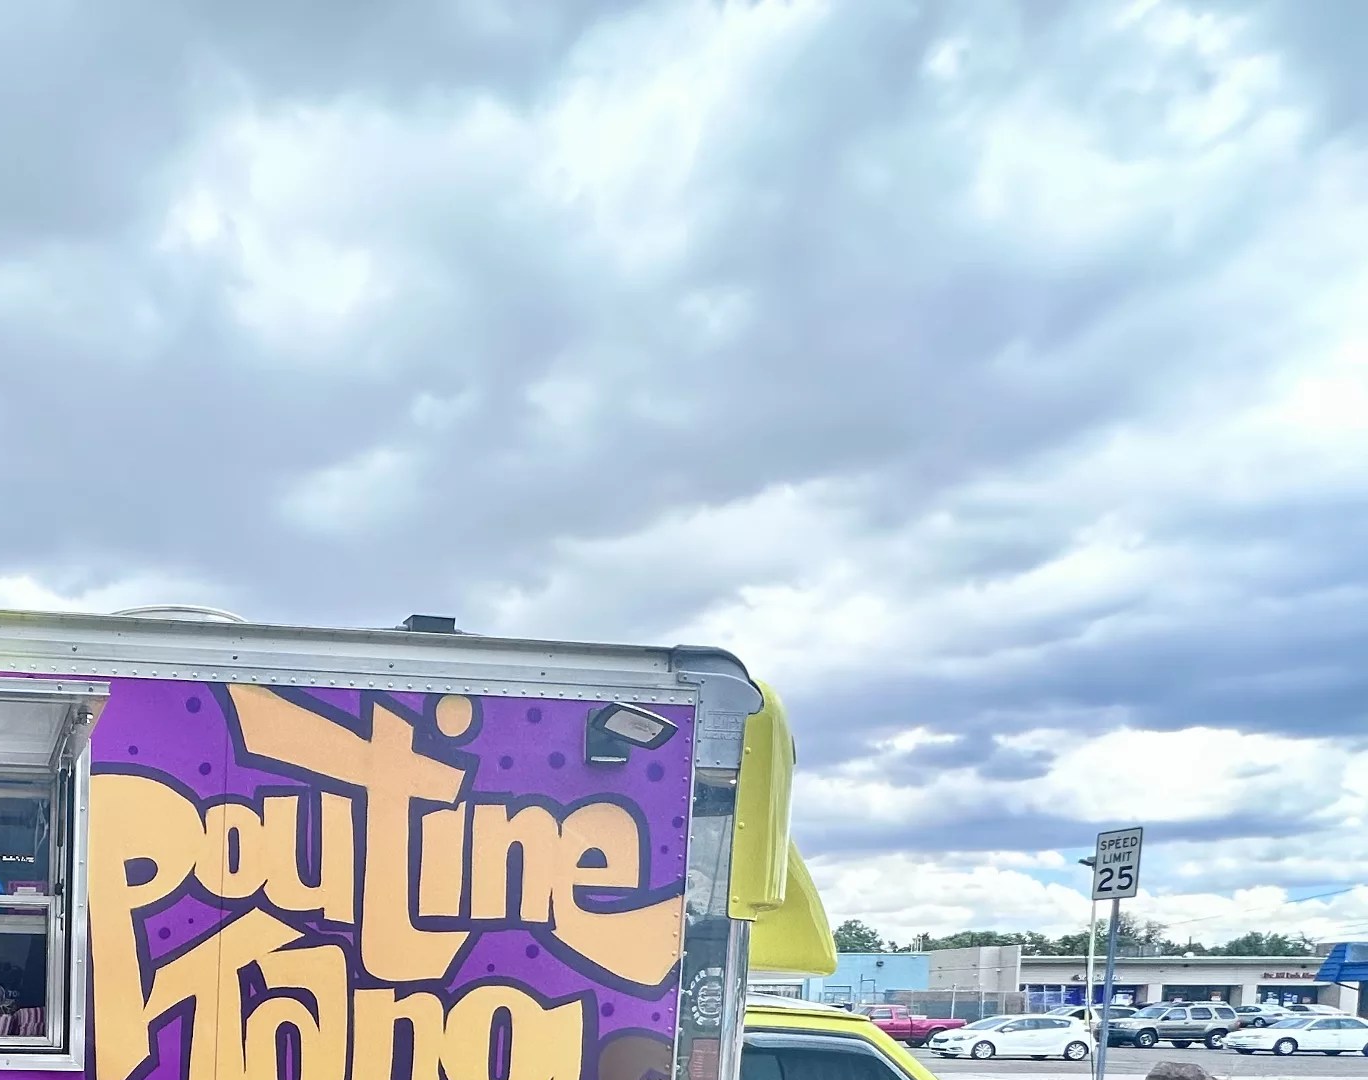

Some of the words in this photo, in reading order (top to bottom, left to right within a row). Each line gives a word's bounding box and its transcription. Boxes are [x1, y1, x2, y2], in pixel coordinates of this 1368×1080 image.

[1100, 836, 1138, 851] SPEED
[1103, 851, 1132, 864] LIMIT
[1097, 865, 1133, 892] 25
